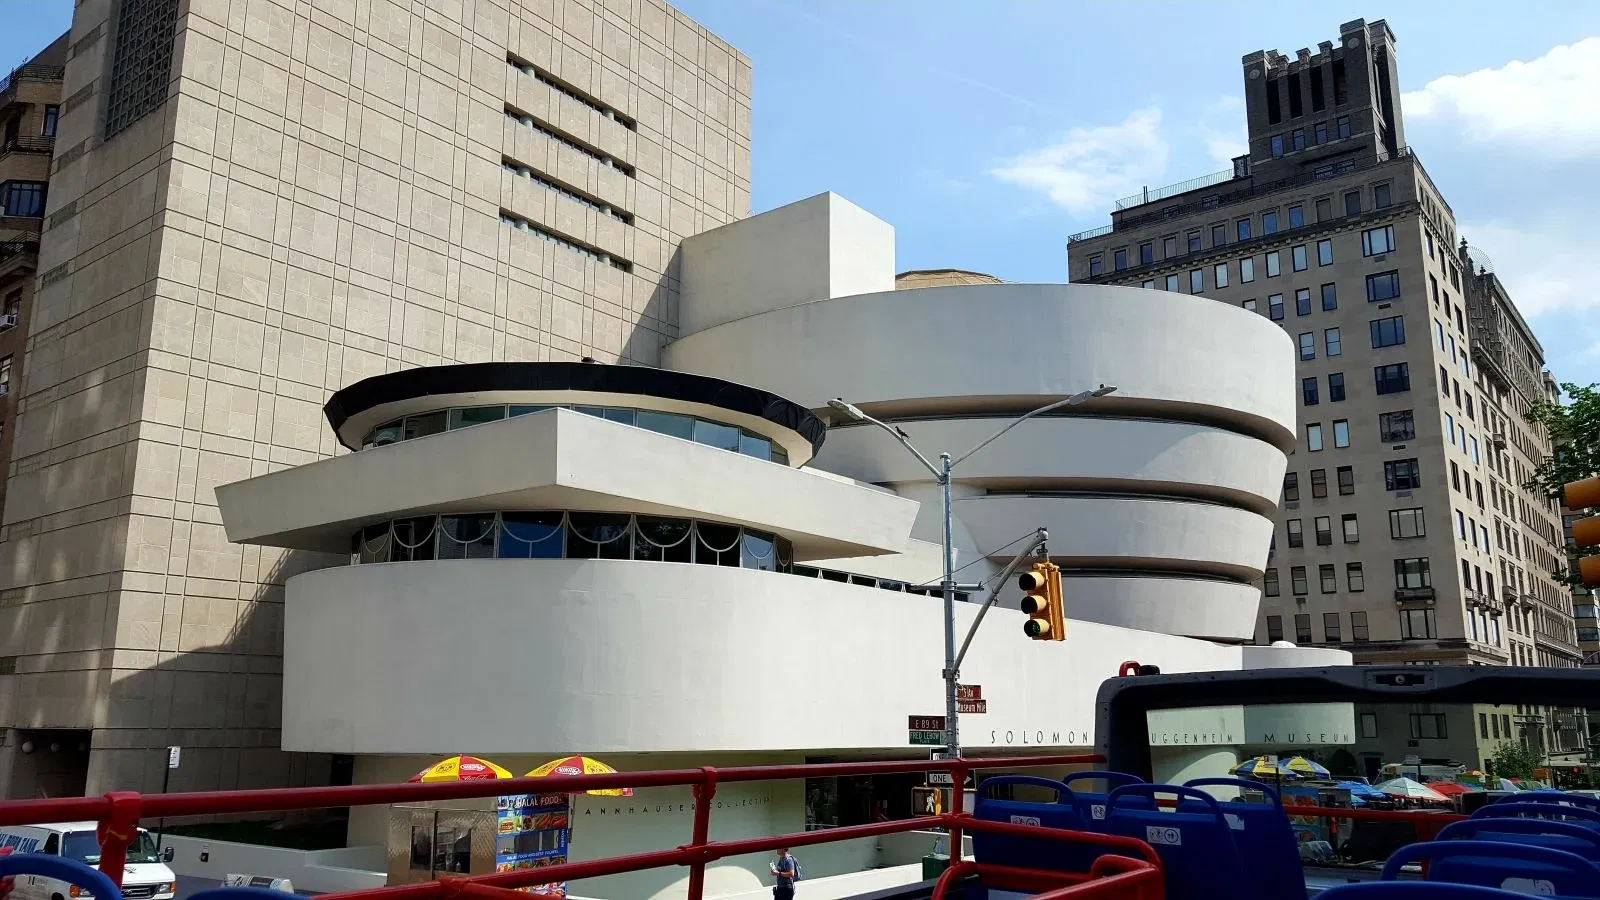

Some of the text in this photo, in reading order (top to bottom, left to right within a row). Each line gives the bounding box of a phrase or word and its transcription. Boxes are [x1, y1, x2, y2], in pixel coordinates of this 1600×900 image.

[915, 719, 939, 729] E 89 St
[991, 730, 1349, 744] SOLOMON UGGENHEIM MUSEUM
[932, 774, 947, 783] ONE
[516, 795, 560, 808] HALAL FOOD
[571, 797, 770, 815] ANNHAUSER OLLECTION
